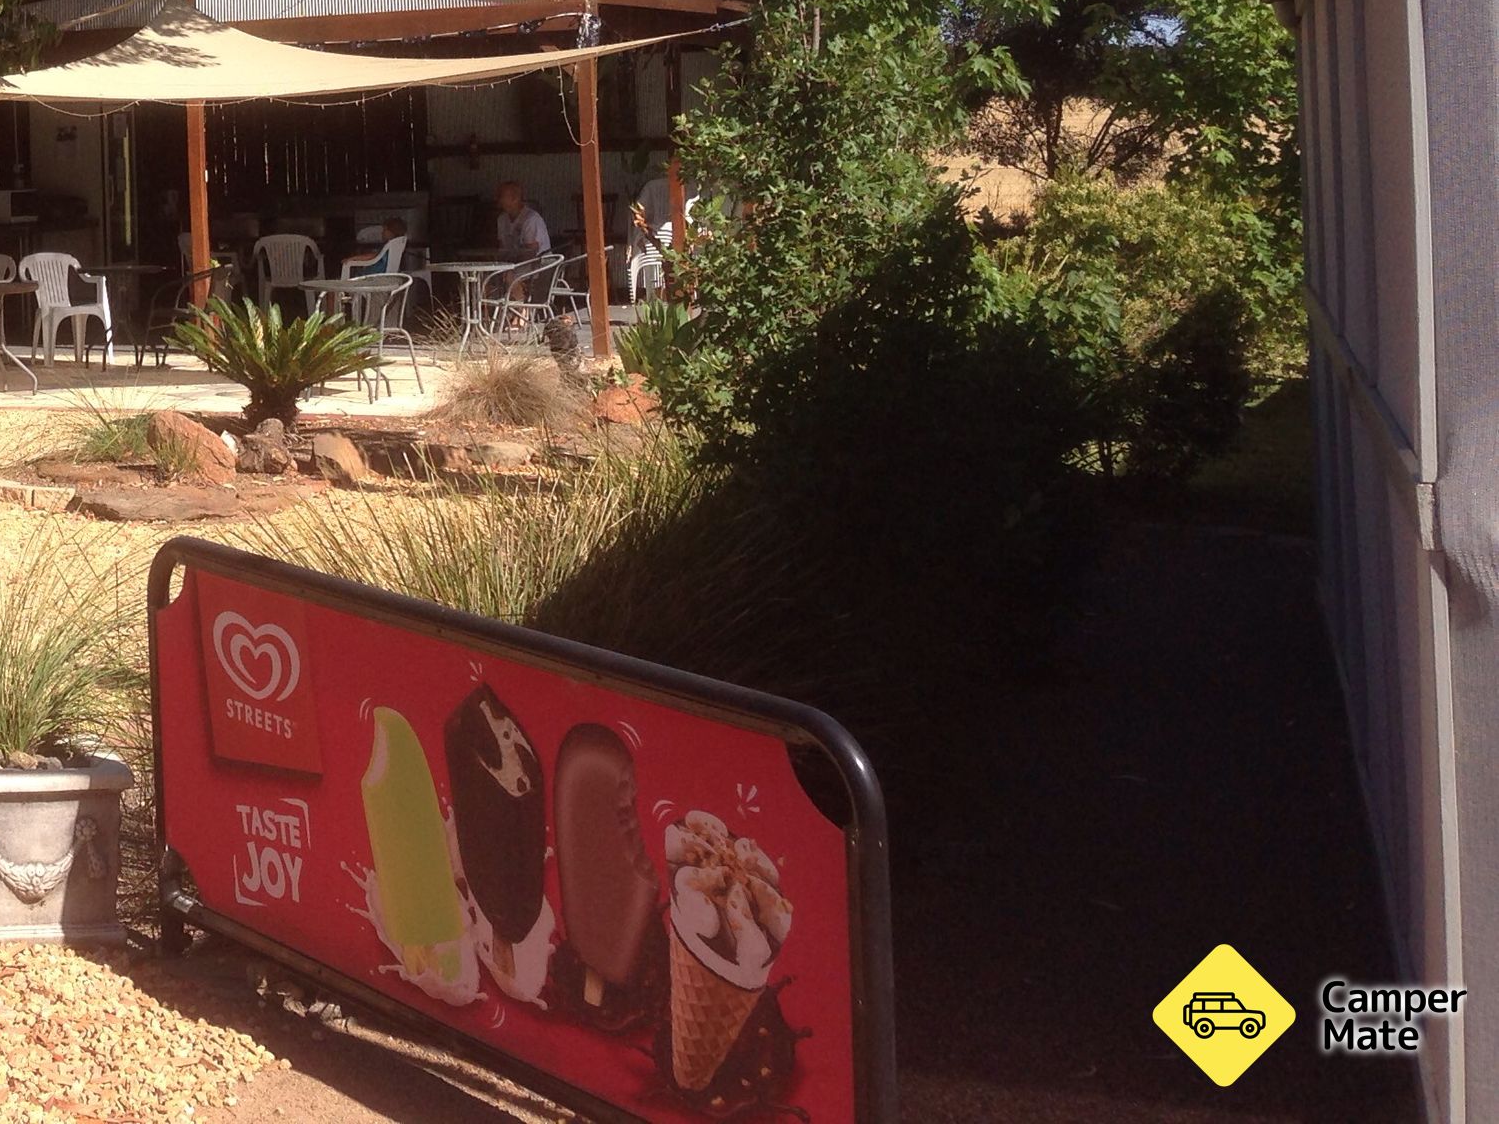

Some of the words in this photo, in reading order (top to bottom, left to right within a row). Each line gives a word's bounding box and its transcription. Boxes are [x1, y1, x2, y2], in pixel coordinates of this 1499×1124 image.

[226, 698, 293, 740] STREETS
[236, 804, 302, 849] TASTE
[242, 841, 303, 903] JOY
